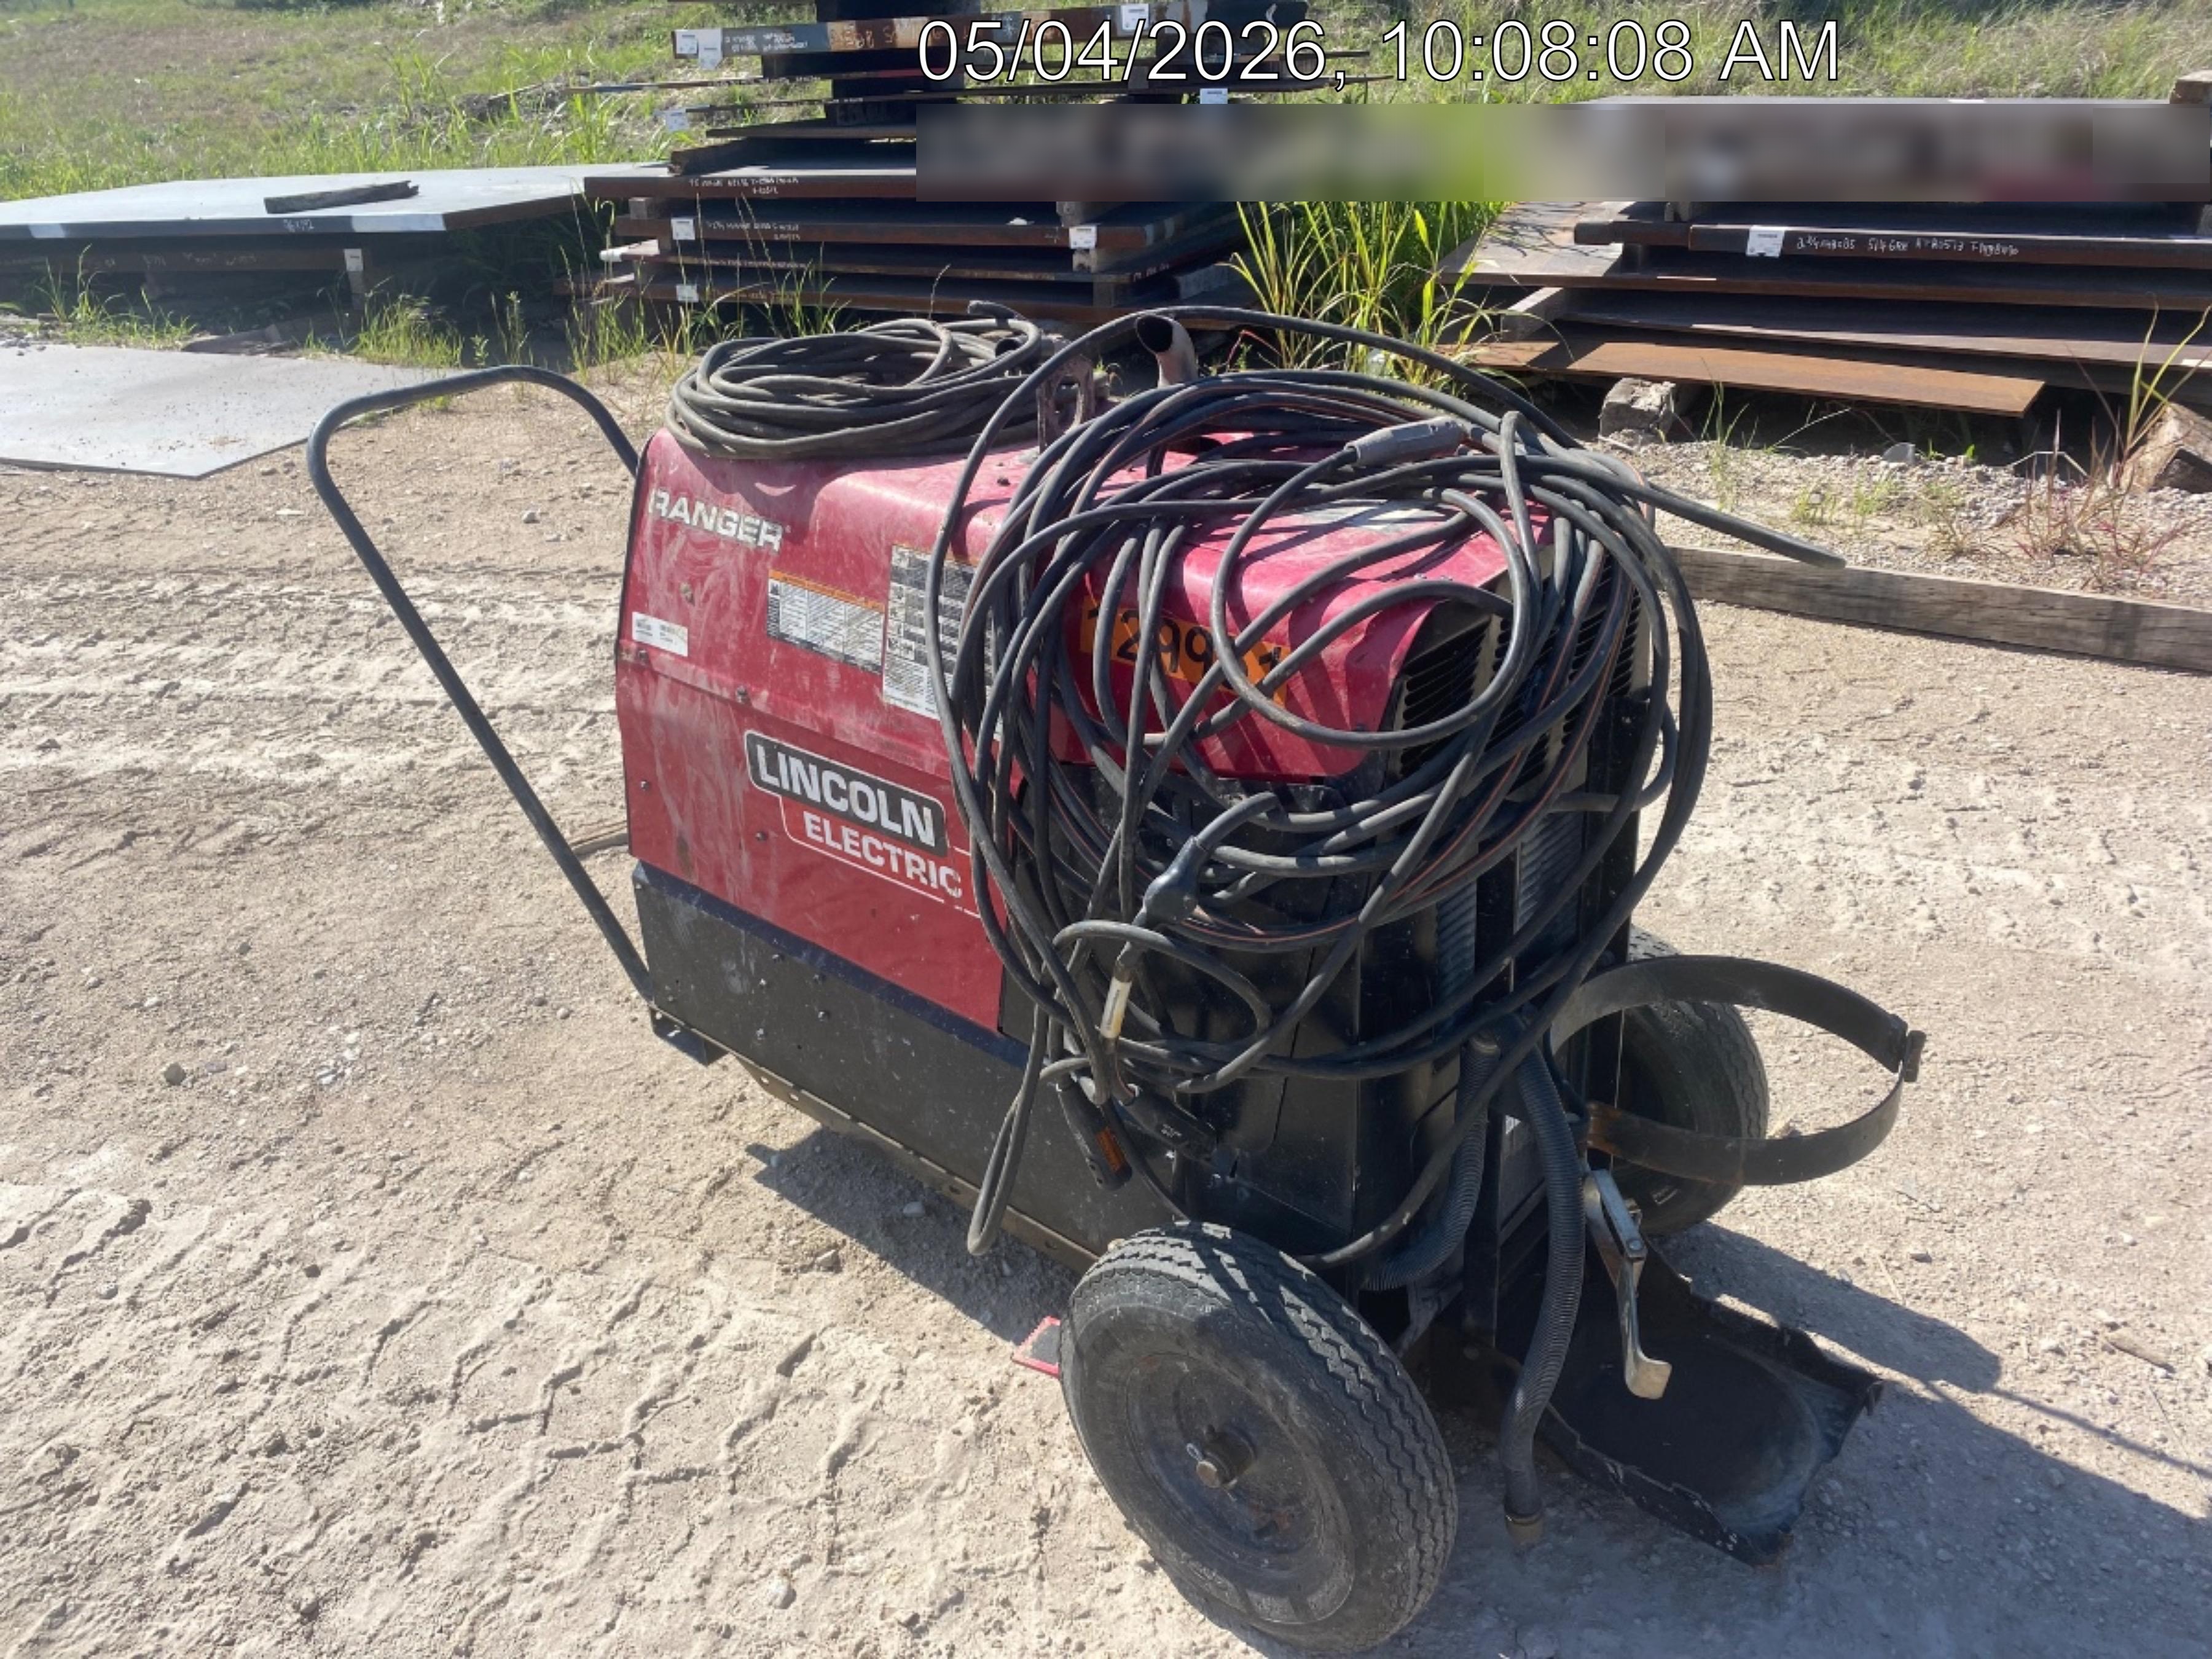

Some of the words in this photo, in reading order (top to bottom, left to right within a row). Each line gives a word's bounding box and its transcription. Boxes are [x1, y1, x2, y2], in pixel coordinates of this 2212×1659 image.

[648, 487, 783, 553] RANGER
[756, 744, 936, 847] LINCOLN
[803, 810, 963, 898] ELECTRIC
